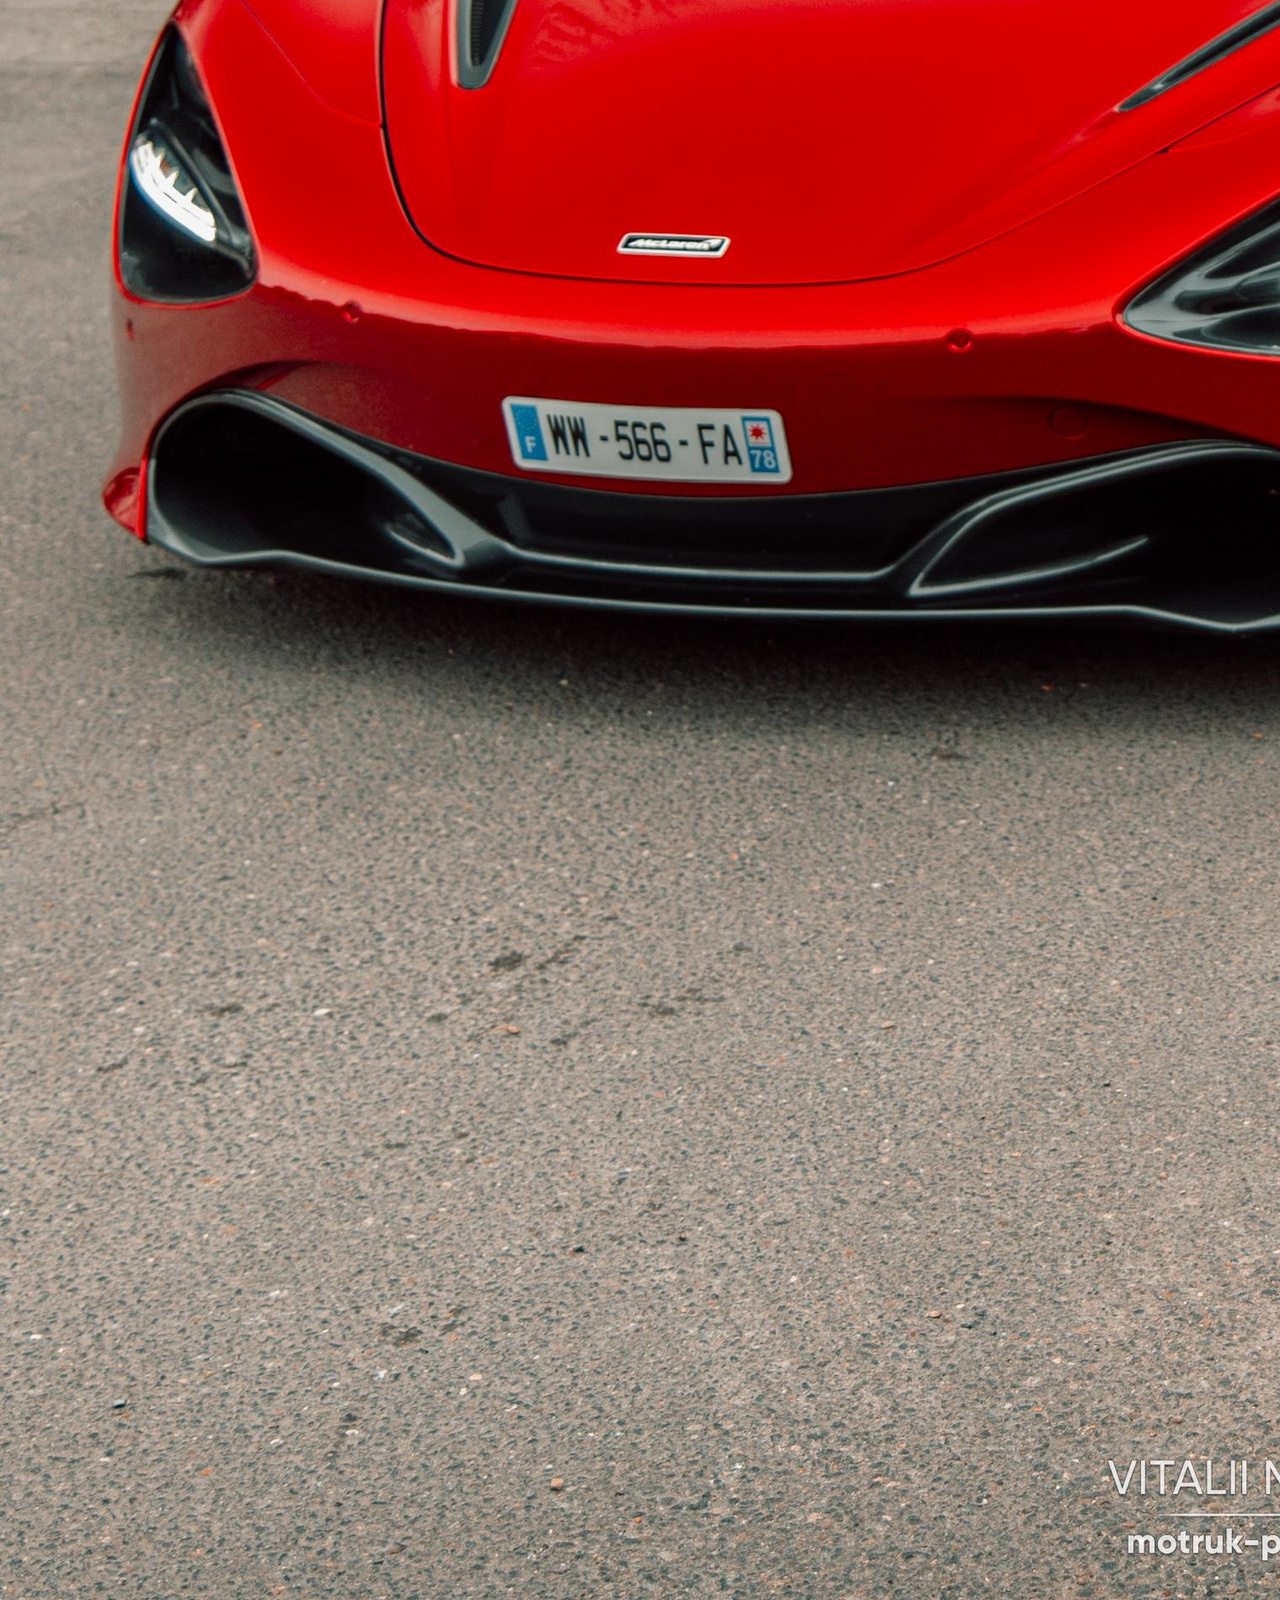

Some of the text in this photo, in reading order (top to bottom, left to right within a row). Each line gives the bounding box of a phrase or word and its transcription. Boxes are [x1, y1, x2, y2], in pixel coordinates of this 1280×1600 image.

[627, 238, 713, 251] McLaren
[525, 435, 536, 453] F
[750, 449, 777, 470] 78
